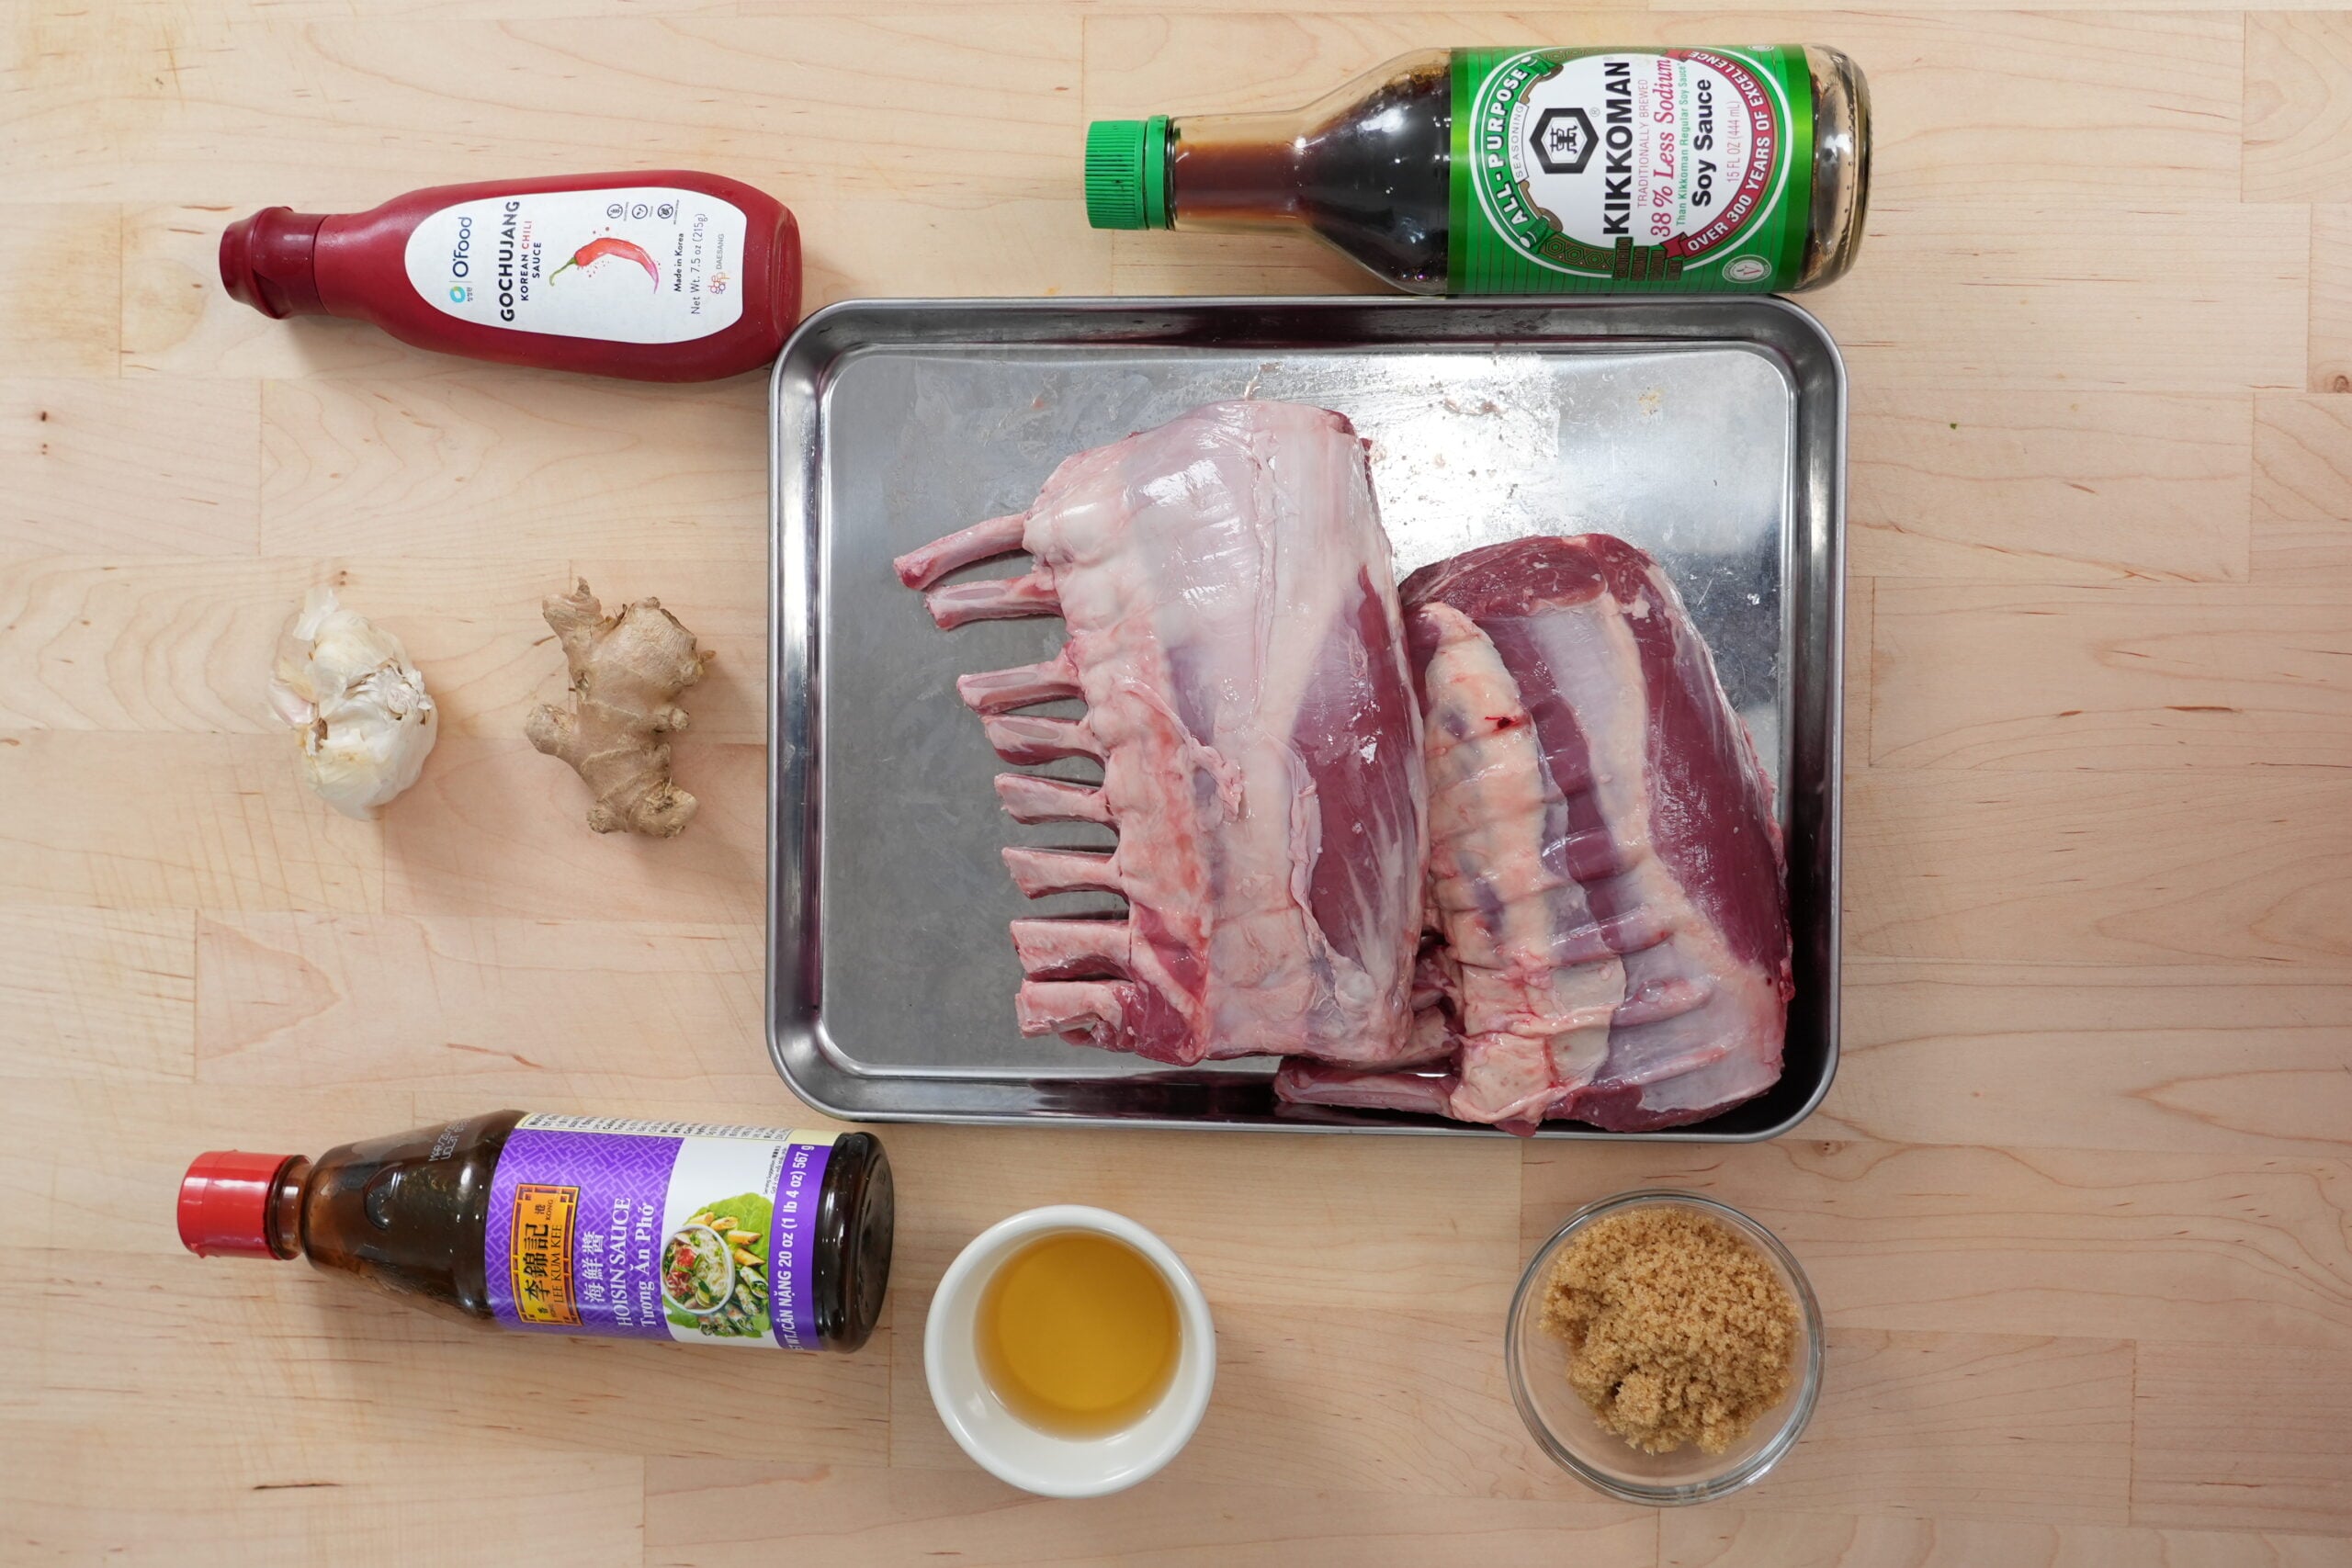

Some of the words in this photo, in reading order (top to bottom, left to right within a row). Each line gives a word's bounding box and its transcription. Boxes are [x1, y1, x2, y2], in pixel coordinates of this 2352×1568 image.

[1652, 59, 1675, 124] Sodium
[1690, 51, 1764, 107] EXCELLENCE
[1638, 80, 1649, 118] BREWED
[1679, 90, 1689, 105] Soy
[1725, 100, 1742, 118] mL)
[1679, 107, 1690, 146] Regular
[1693, 79, 1713, 151] Sauce
[1754, 111, 1770, 130] OF
[1511, 105, 1524, 178] SEASONING
[1726, 120, 1744, 141] (444
[1486, 68, 1529, 225] ALL-PURPOSE
[1603, 62, 1633, 234] KIKKOMAN
[1653, 131, 1675, 179] Less
[1727, 141, 1741, 155] OZ
[1637, 122, 1649, 209] TRADITIONALLY
[1678, 148, 1690, 199] Kikkoman
[1727, 155, 1741, 168] FL
[1727, 169, 1740, 182] 15
[1745, 137, 1770, 190] YEARS
[1691, 157, 1716, 207] Soy
[1676, 202, 1687, 226] Than
[1726, 194, 1752, 222] 300
[521, 220, 532, 250] CHILI
[692, 213, 708, 243] (215g)
[1687, 221, 1729, 252] OVER
[674, 232, 684, 256] Korea
[695, 244, 701, 255] oz
[716, 233, 725, 270] DAESANG
[498, 201, 520, 322] GOCHUJANG
[532, 242, 542, 278] SAUCE
[674, 258, 683, 267] in
[690, 258, 701, 273] 7.5
[520, 254, 529, 301] KOREAN
[673, 270, 683, 292] Made
[691, 277, 701, 294] Wt.
[691, 296, 701, 315] Net
[792, 1152, 809, 1169] 567
[789, 1171, 807, 1188] oz)
[783, 1201, 797, 1213] lb
[786, 1190, 799, 1199] 4
[546, 1199, 554, 1221] KONG
[635, 1201, 655, 1242] Phở
[781, 1217, 797, 1229] (1
[551, 1224, 562, 1248] KEE
[608, 1197, 631, 1266] SAUCE
[782, 1232, 794, 1247] oz
[522, 1223, 550, 1303] 李錦記
[551, 1250, 562, 1281] KUM
[581, 1231, 605, 1303] 海鮮醬
[629, 1248, 650, 1276] Ăn
[778, 1252, 793, 1268] 20
[553, 1286, 564, 1303] LEE
[609, 1268, 634, 1327] HOISIN
[774, 1270, 796, 1307] NẶNG
